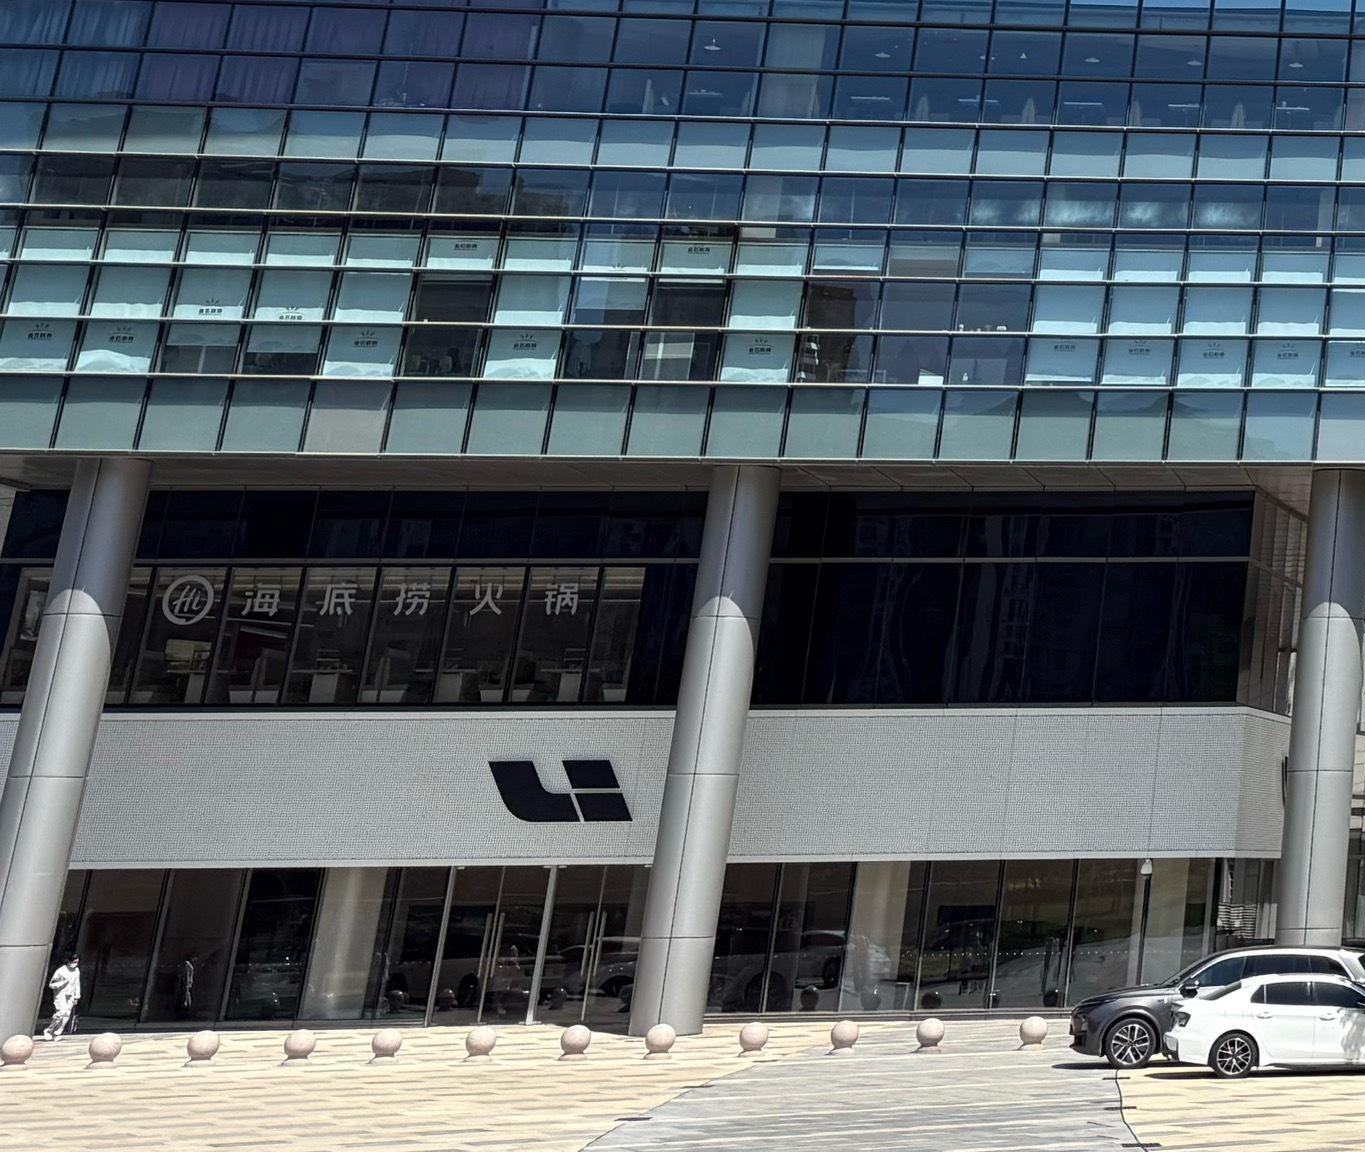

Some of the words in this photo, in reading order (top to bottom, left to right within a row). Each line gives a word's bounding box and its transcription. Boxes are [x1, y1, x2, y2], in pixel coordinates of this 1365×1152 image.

[241, 582, 579, 617] 海底捞火锅
